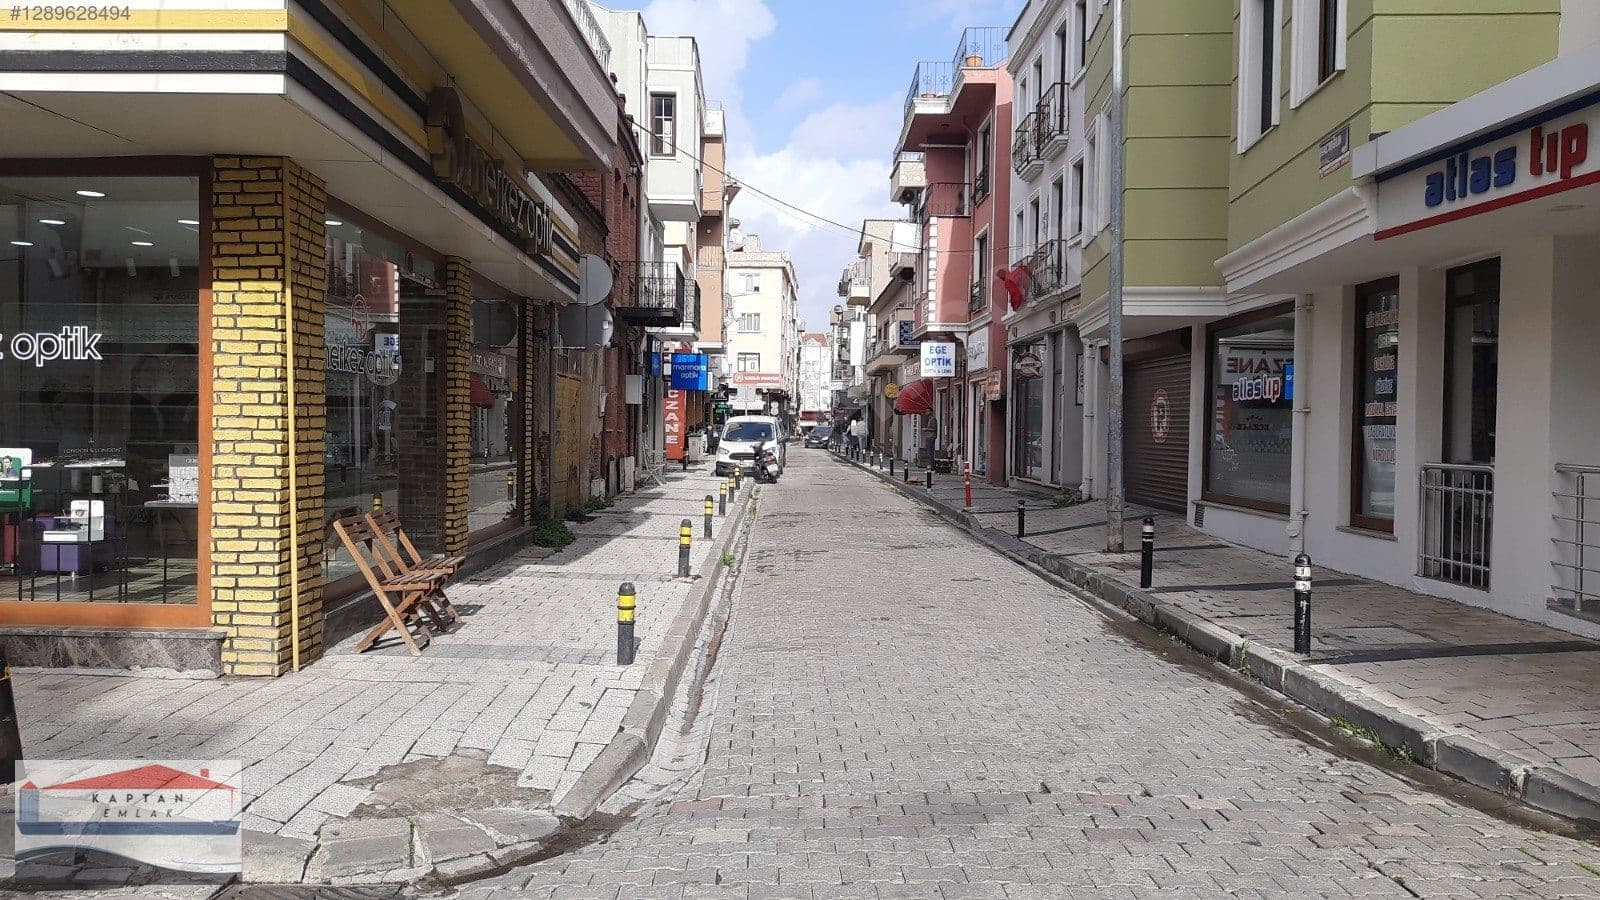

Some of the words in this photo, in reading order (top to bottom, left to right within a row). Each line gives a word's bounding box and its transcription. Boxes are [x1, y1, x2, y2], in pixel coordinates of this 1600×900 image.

[1425, 147, 1517, 207] atlas
[11, 326, 103, 367] optik
[325, 341, 365, 374] erkez
[924, 356, 952, 366] OPTİK
[929, 346, 947, 354] EGE
[1233, 377, 1261, 401] atlas
[665, 383, 679, 444] CZANE
